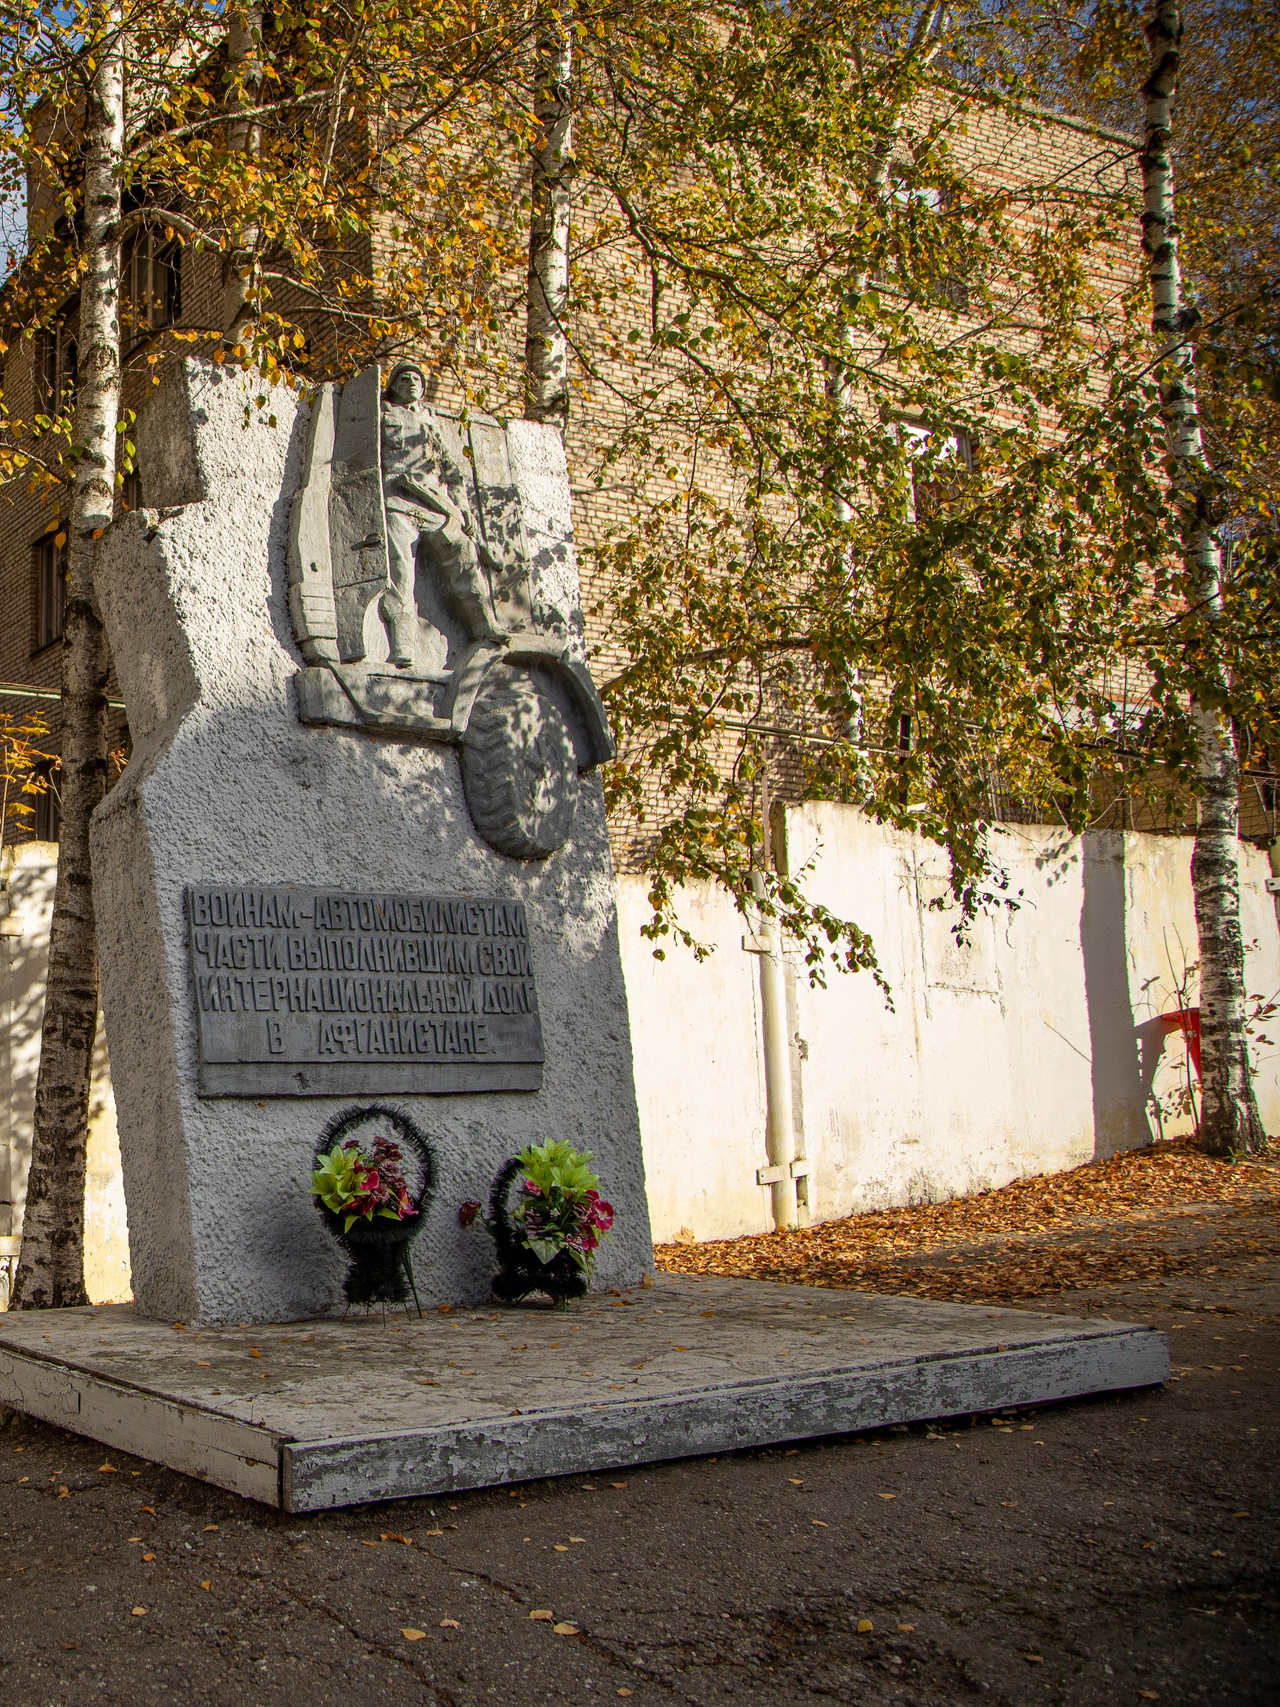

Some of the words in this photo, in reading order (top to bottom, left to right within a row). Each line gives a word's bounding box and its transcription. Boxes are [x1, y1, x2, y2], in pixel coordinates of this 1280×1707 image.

[287, 935, 476, 975] ВЫПОЛНИВШИМ
[477, 938, 534, 976] СВОЙ
[199, 976, 480, 1014] ИНТЕРНАЦИОНАЛЬНЫЙ
[482, 980, 536, 1014] ДОЛГ
[266, 1018, 287, 1054] В
